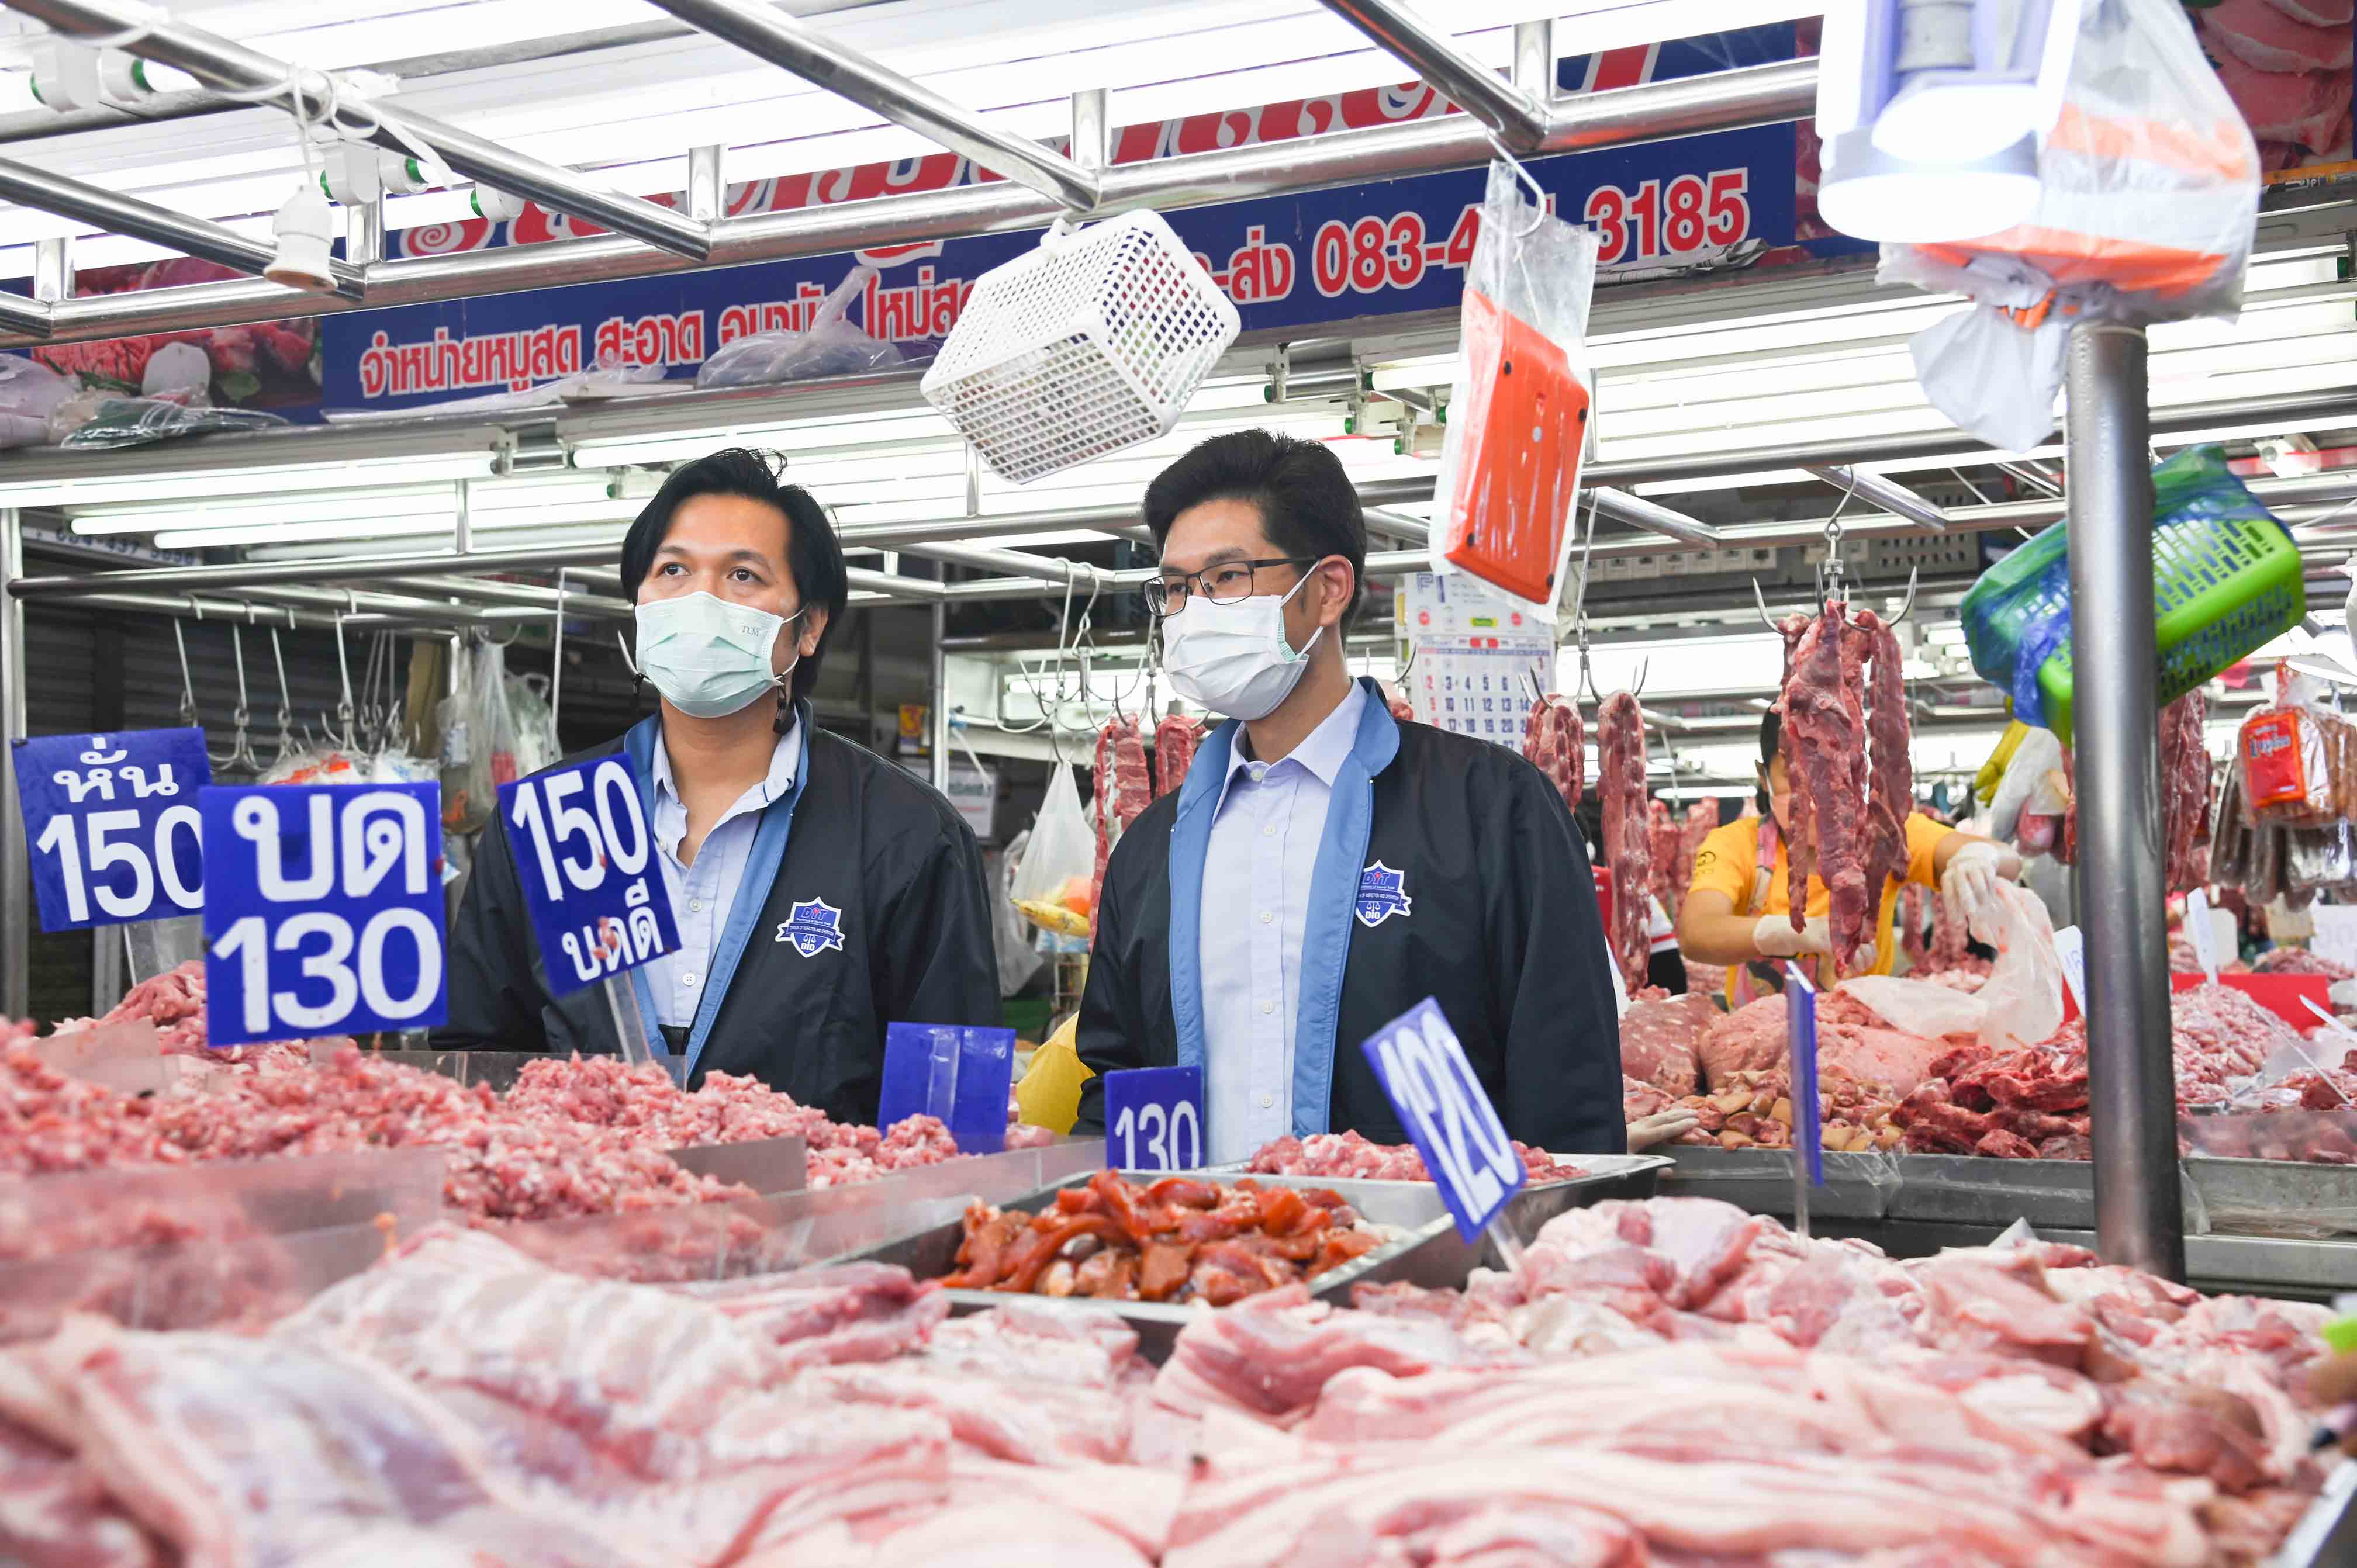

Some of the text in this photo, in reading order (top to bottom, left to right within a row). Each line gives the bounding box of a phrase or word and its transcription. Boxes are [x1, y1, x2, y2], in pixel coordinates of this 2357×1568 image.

[360, 324, 582, 398] จำหน่ายหมูสด
[595, 310, 704, 371] สะอาด
[1445, 676, 1452, 691] 3
[1464, 676, 1471, 691] 4
[1464, 697, 1475, 712] 11
[1482, 697, 1493, 712] 12
[53, 736, 179, 802] หั่น
[36, 805, 205, 922] 150
[233, 791, 428, 902] บด
[512, 761, 648, 901] 150
[212, 907, 443, 1034] 130
[561, 878, 664, 981] บดดี
[1115, 1100, 1200, 1170] 130
[1377, 1010, 1519, 1225] 120
